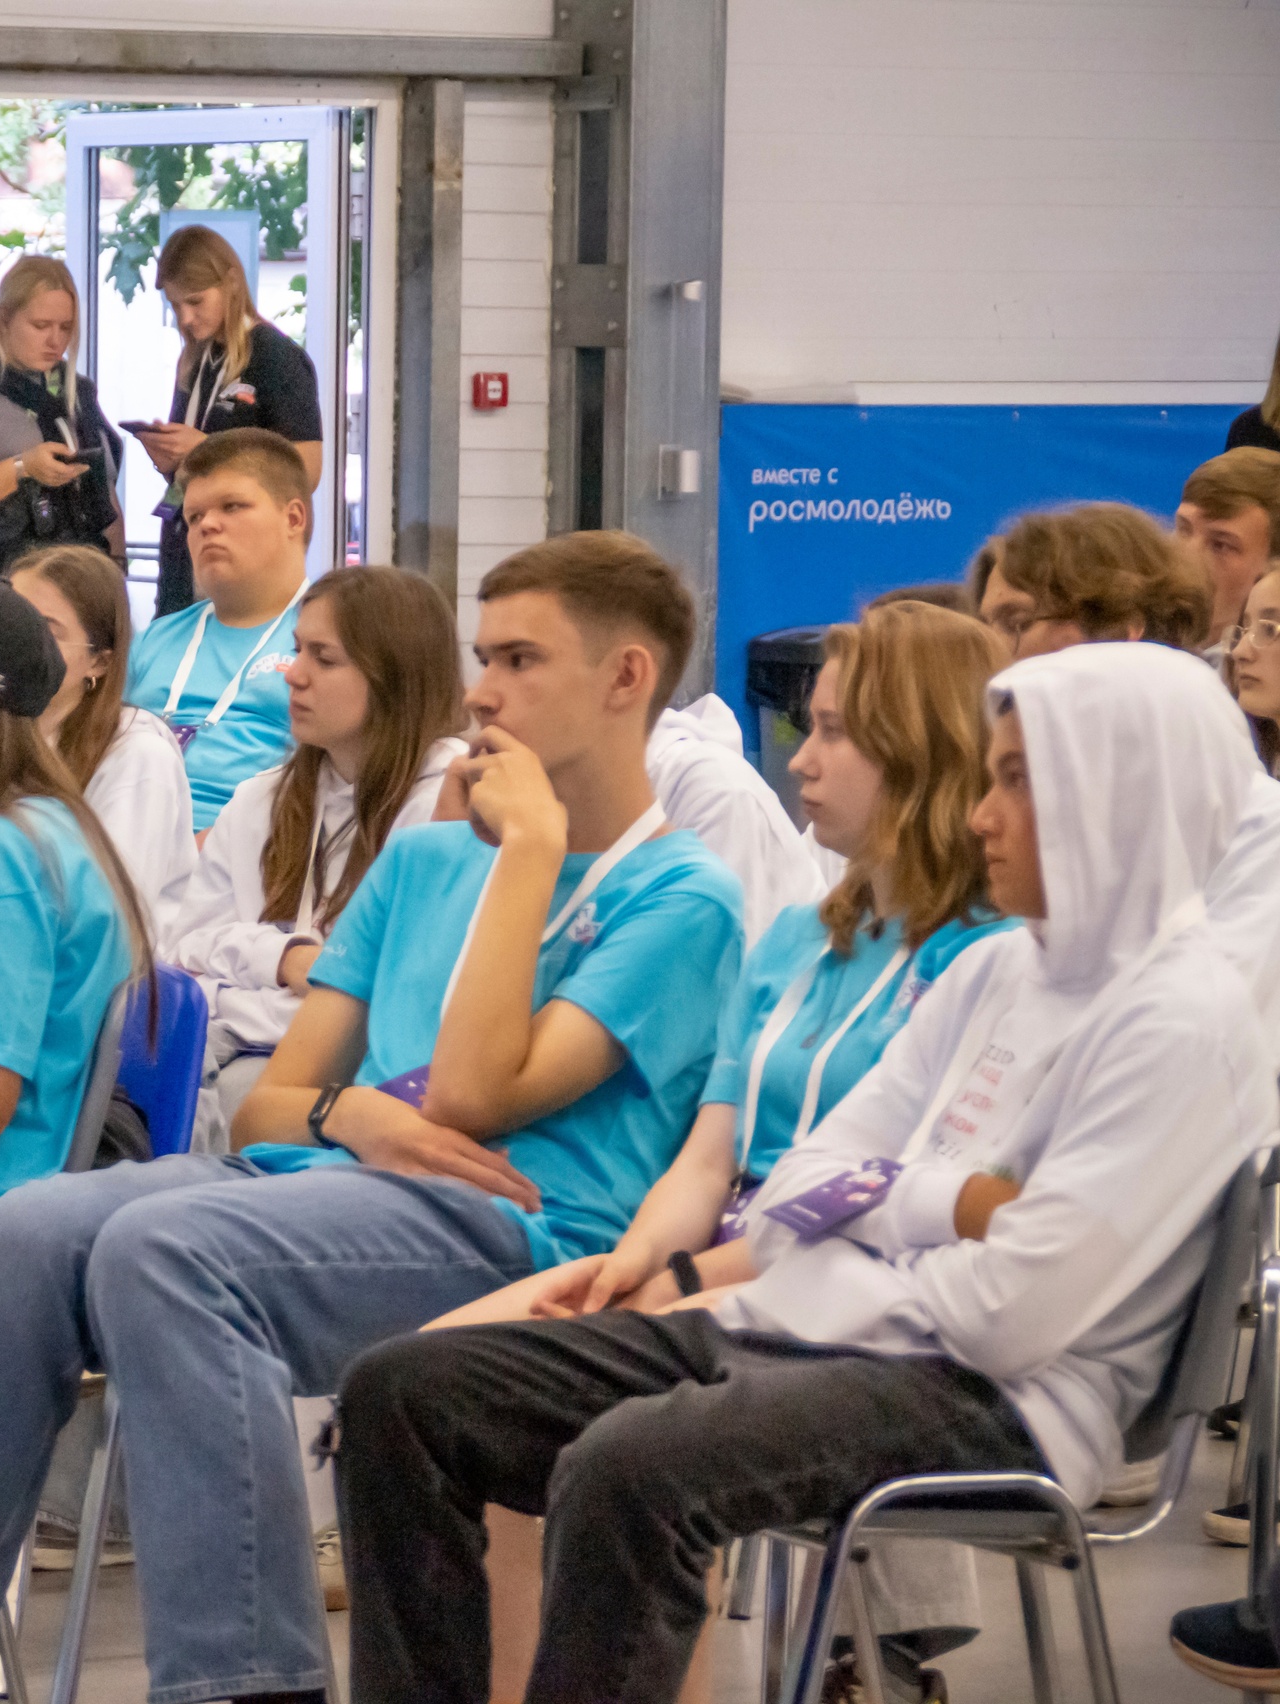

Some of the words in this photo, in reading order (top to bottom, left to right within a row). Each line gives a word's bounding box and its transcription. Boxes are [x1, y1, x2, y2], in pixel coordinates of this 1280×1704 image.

[751, 467, 821, 485] вместе
[827, 467, 839, 484] с
[748, 492, 952, 533] росмолодёжь
